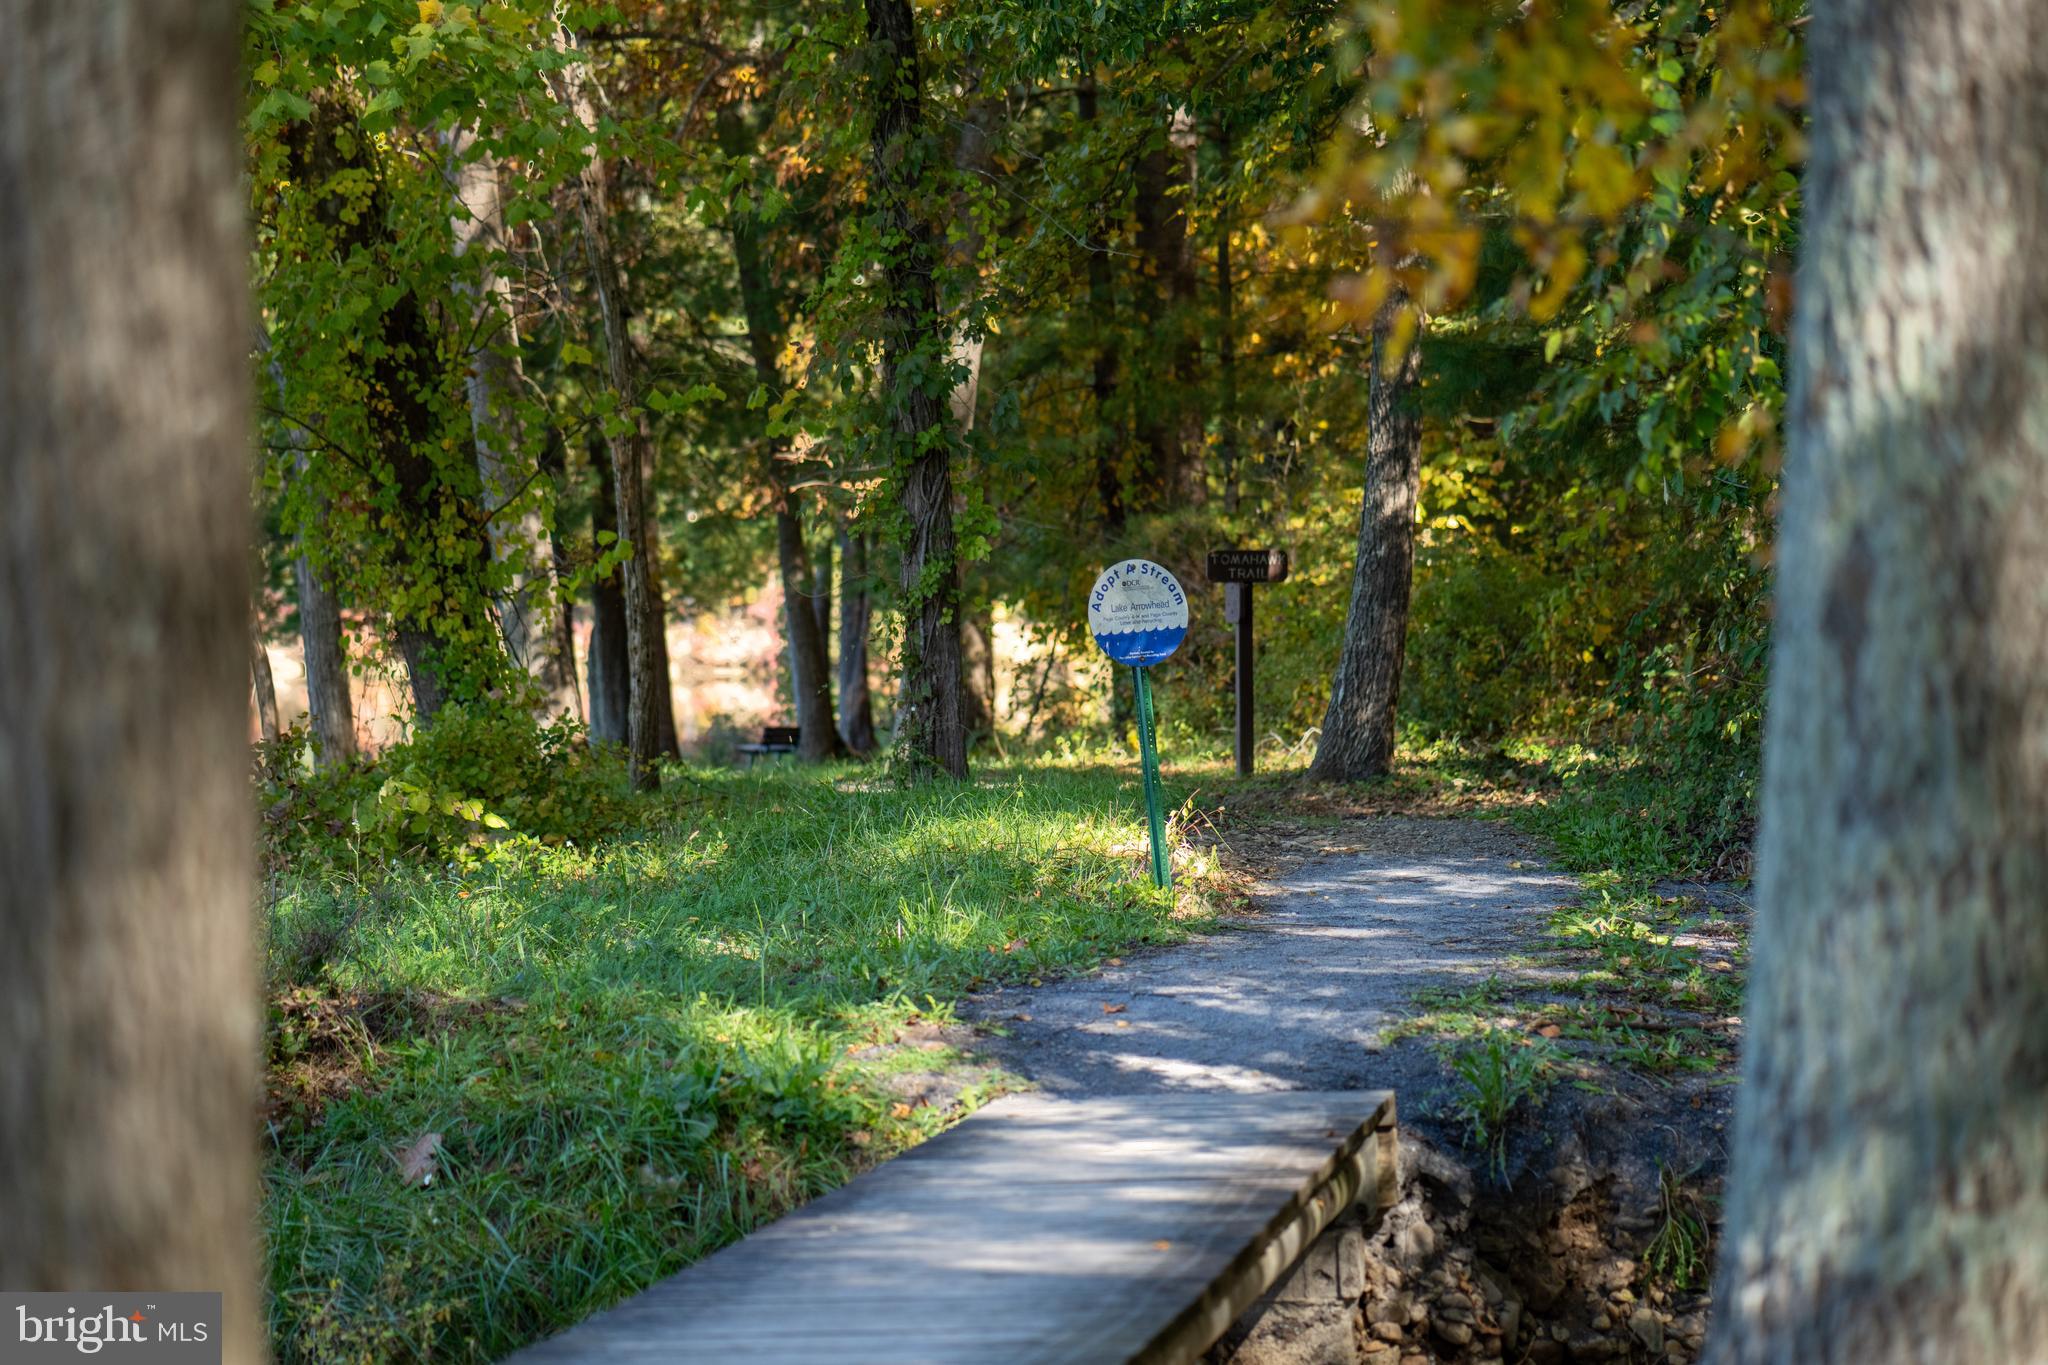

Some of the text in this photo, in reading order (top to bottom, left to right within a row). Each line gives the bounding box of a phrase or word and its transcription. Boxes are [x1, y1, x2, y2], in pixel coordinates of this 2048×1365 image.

[1210, 553, 1286, 565] TOMAHAWK
[1228, 567, 1268, 579] TRAIL
[1091, 563, 1184, 613] Adopt A Stream
[1110, 600, 1170, 613] Lake Arrowhead
